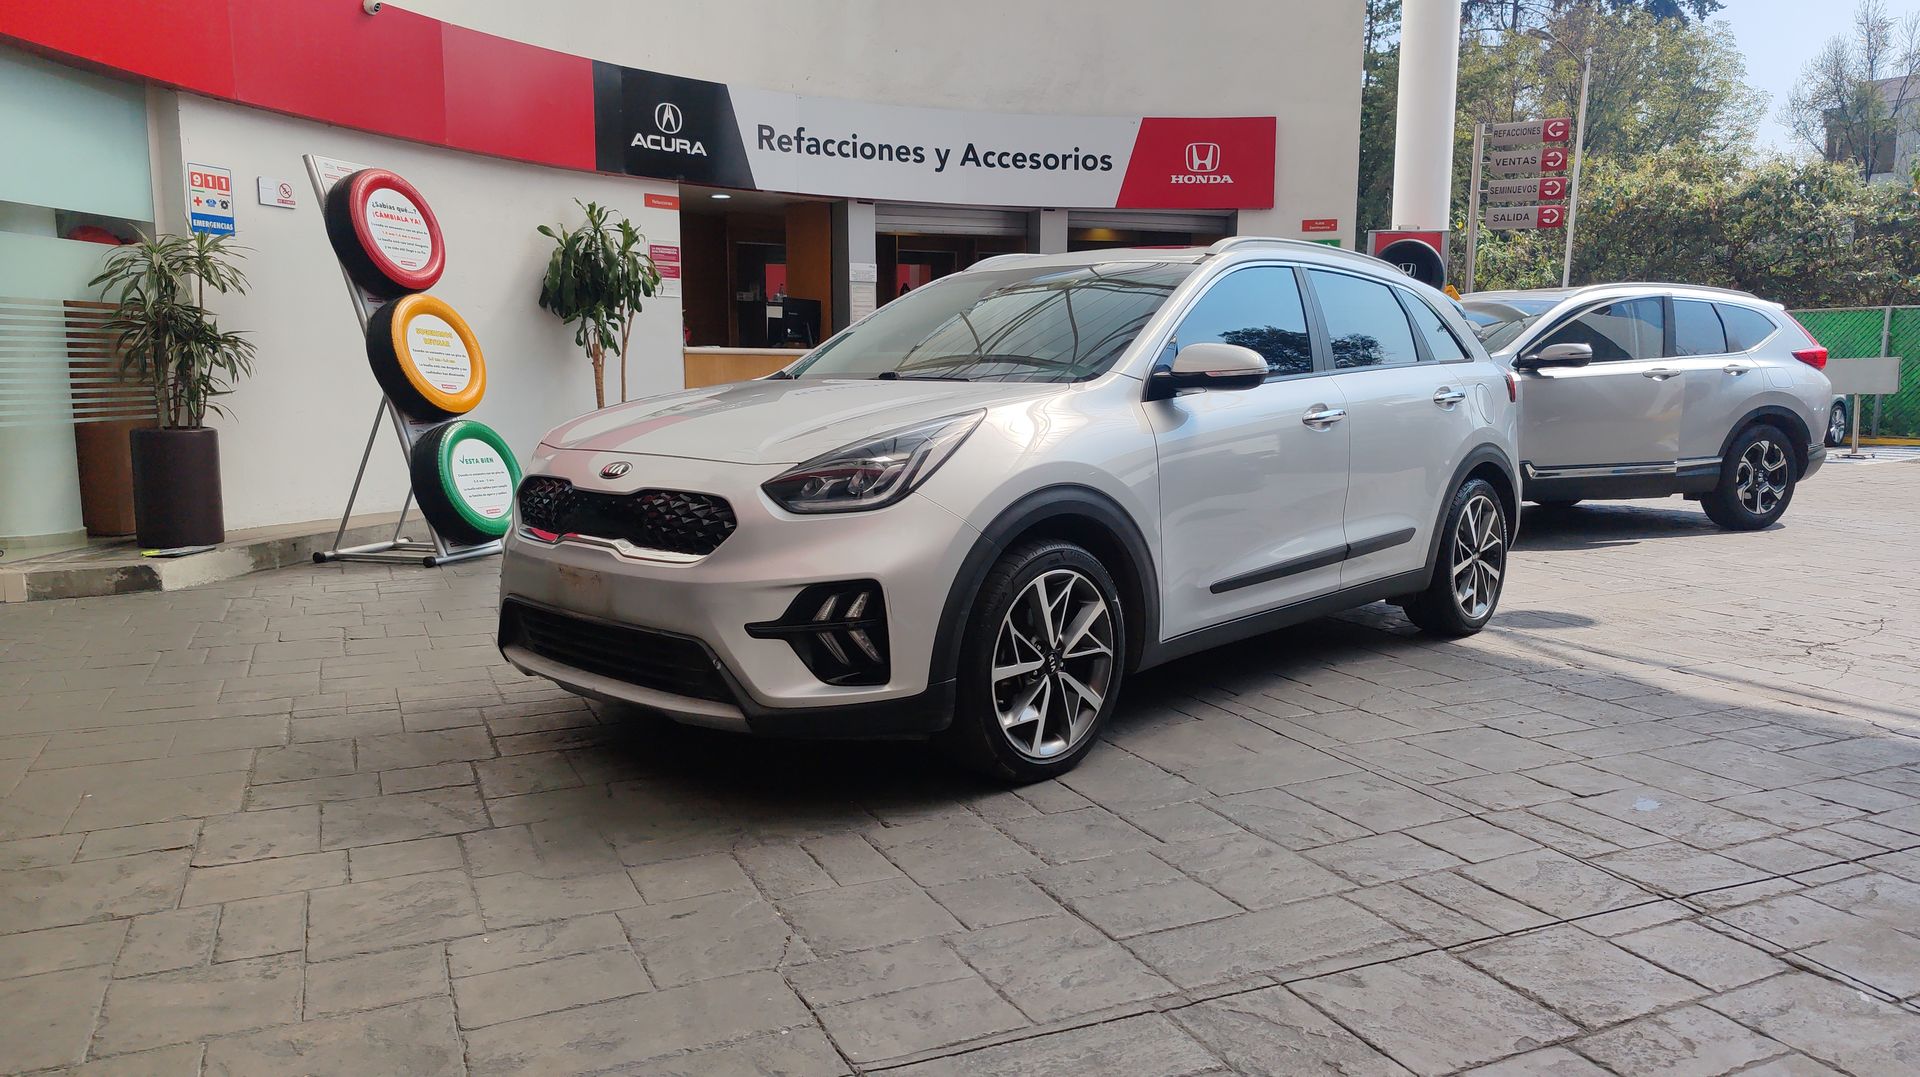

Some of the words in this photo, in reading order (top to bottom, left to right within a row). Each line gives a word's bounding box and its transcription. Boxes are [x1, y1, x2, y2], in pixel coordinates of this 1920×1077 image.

[1493, 126, 1541, 138] REFACCIONES
[631, 132, 708, 157] ACURA
[756, 123, 926, 164] Refacciones
[934, 144, 951, 173] y
[960, 141, 1114, 173] Accesorios
[1495, 156, 1537, 166] VENTAS
[192, 174, 227, 190] 911
[1170, 174, 1234, 185] HONDA
[1490, 184, 1537, 195] SEMINUEVOS
[1493, 212, 1530, 223] SALIDA
[192, 219, 234, 231] EMERGENCIAS
[603, 463, 626, 475] KIA
